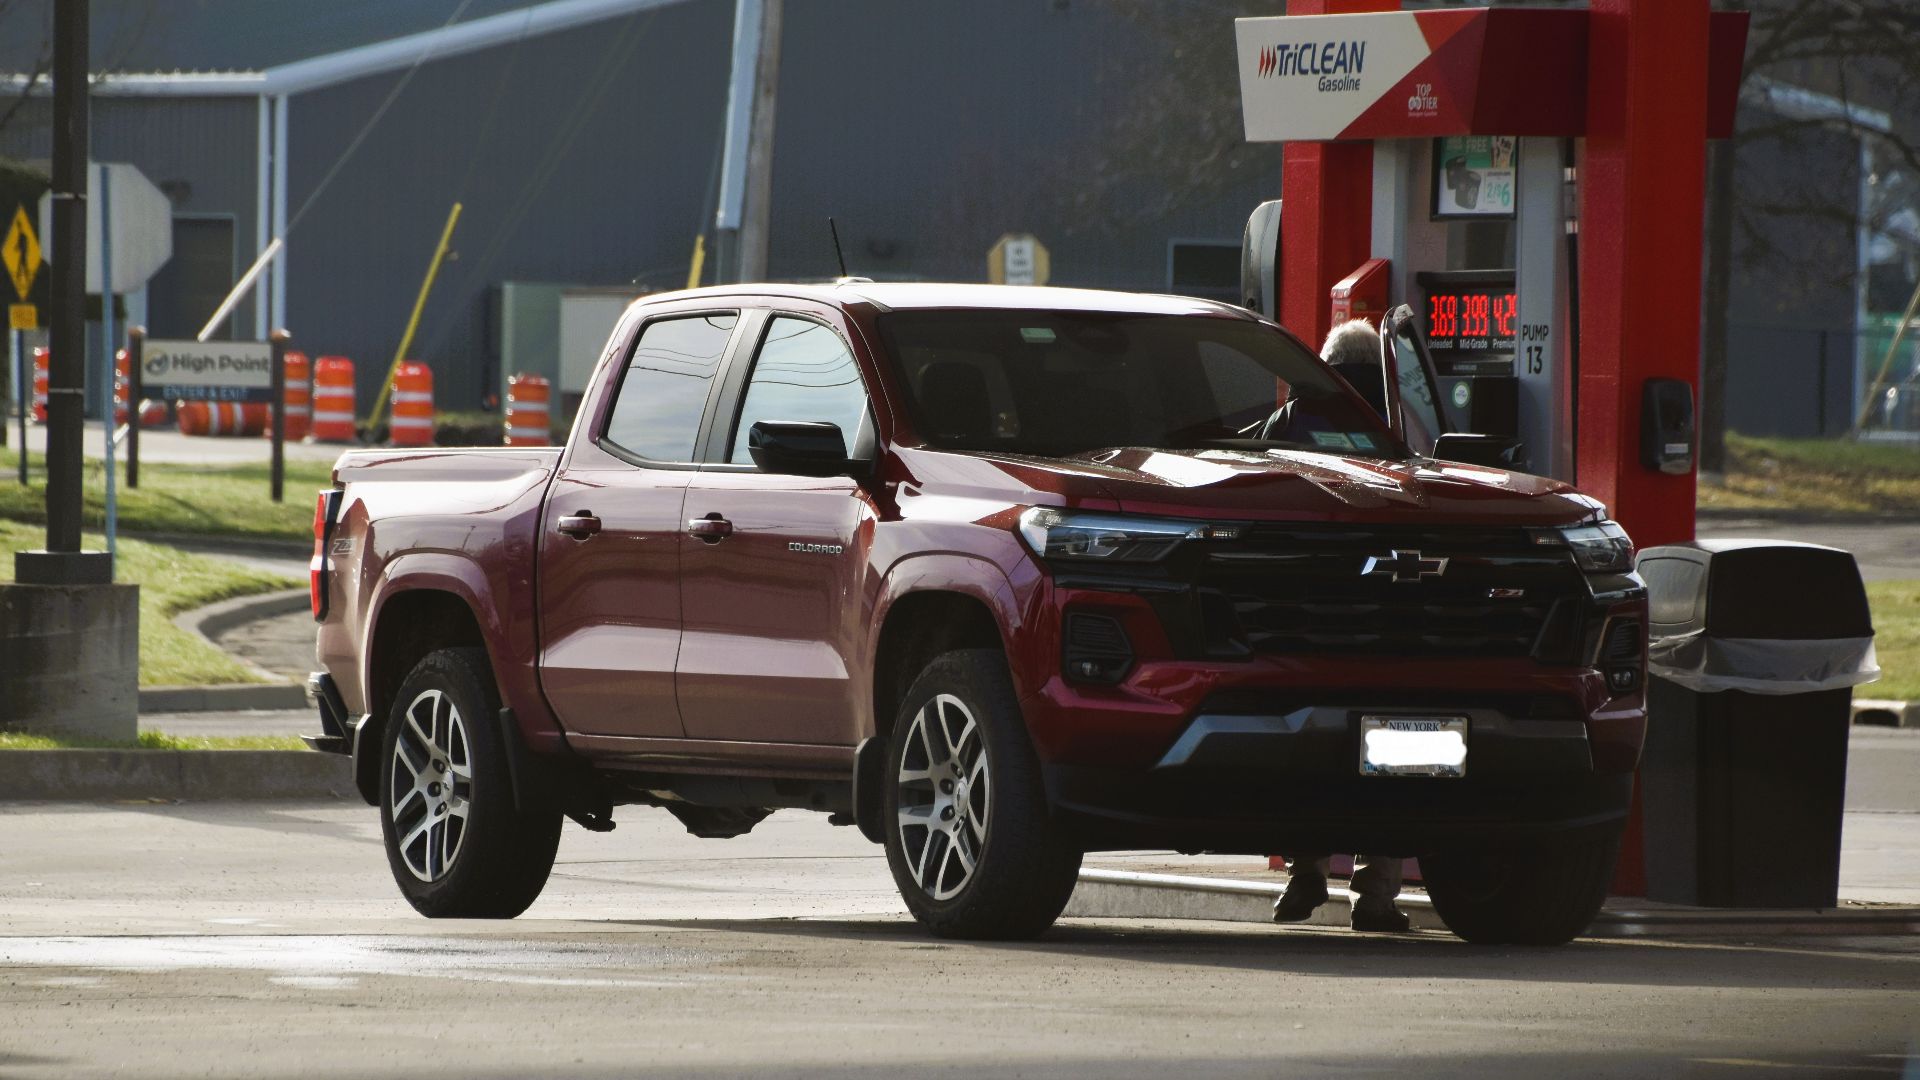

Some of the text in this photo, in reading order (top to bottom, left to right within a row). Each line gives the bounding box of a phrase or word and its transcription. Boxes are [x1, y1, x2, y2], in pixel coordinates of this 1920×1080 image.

[1276, 41, 1366, 76] TriCLEAN
[1318, 75, 1361, 92] Gasoline
[1416, 84, 1431, 97] TOP
[1422, 97, 1438, 110] TIER
[1522, 324, 1549, 341] PUMP
[1427, 338, 1453, 349] Unleaded
[171, 352, 270, 374] High Point
[1527, 346, 1543, 374] 13
[788, 542, 843, 554] COLORADO
[1389, 721, 1440, 732] NEW YORK
